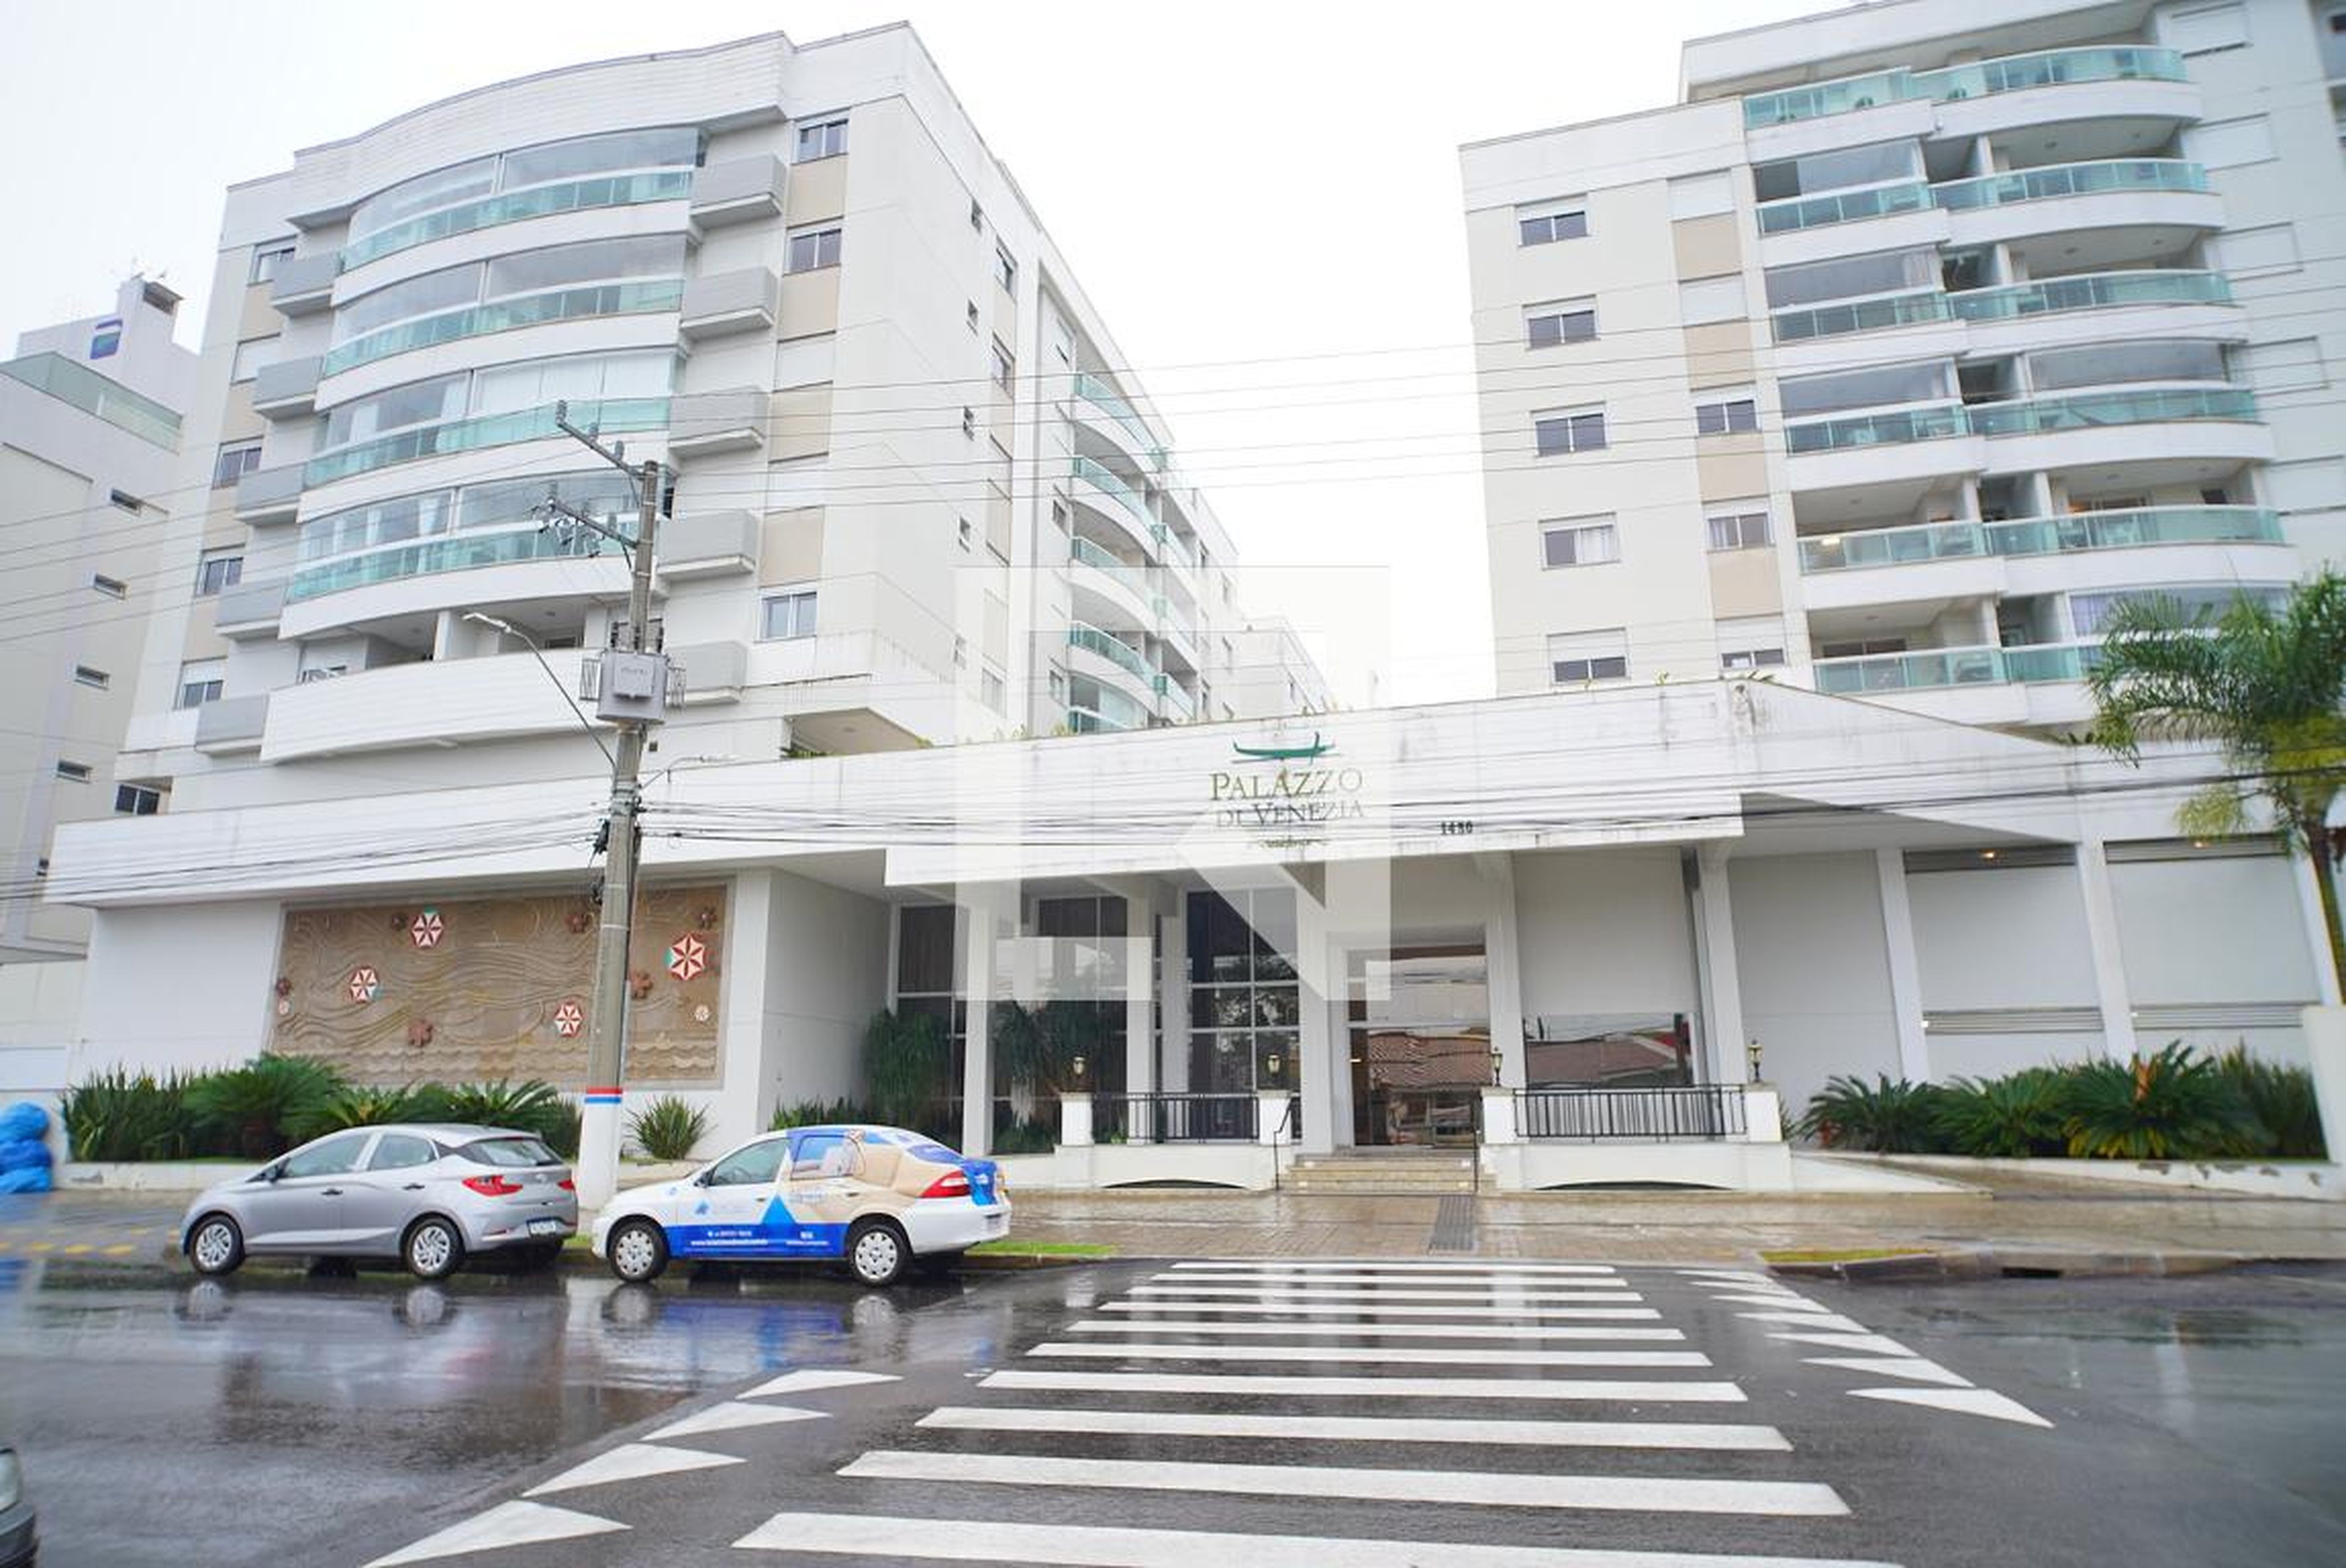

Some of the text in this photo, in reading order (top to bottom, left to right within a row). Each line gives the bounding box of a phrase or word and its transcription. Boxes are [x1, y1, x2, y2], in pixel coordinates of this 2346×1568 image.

[1210, 767, 1363, 801] PALAZZO
[1218, 800, 1364, 827] DI VENEZIA
